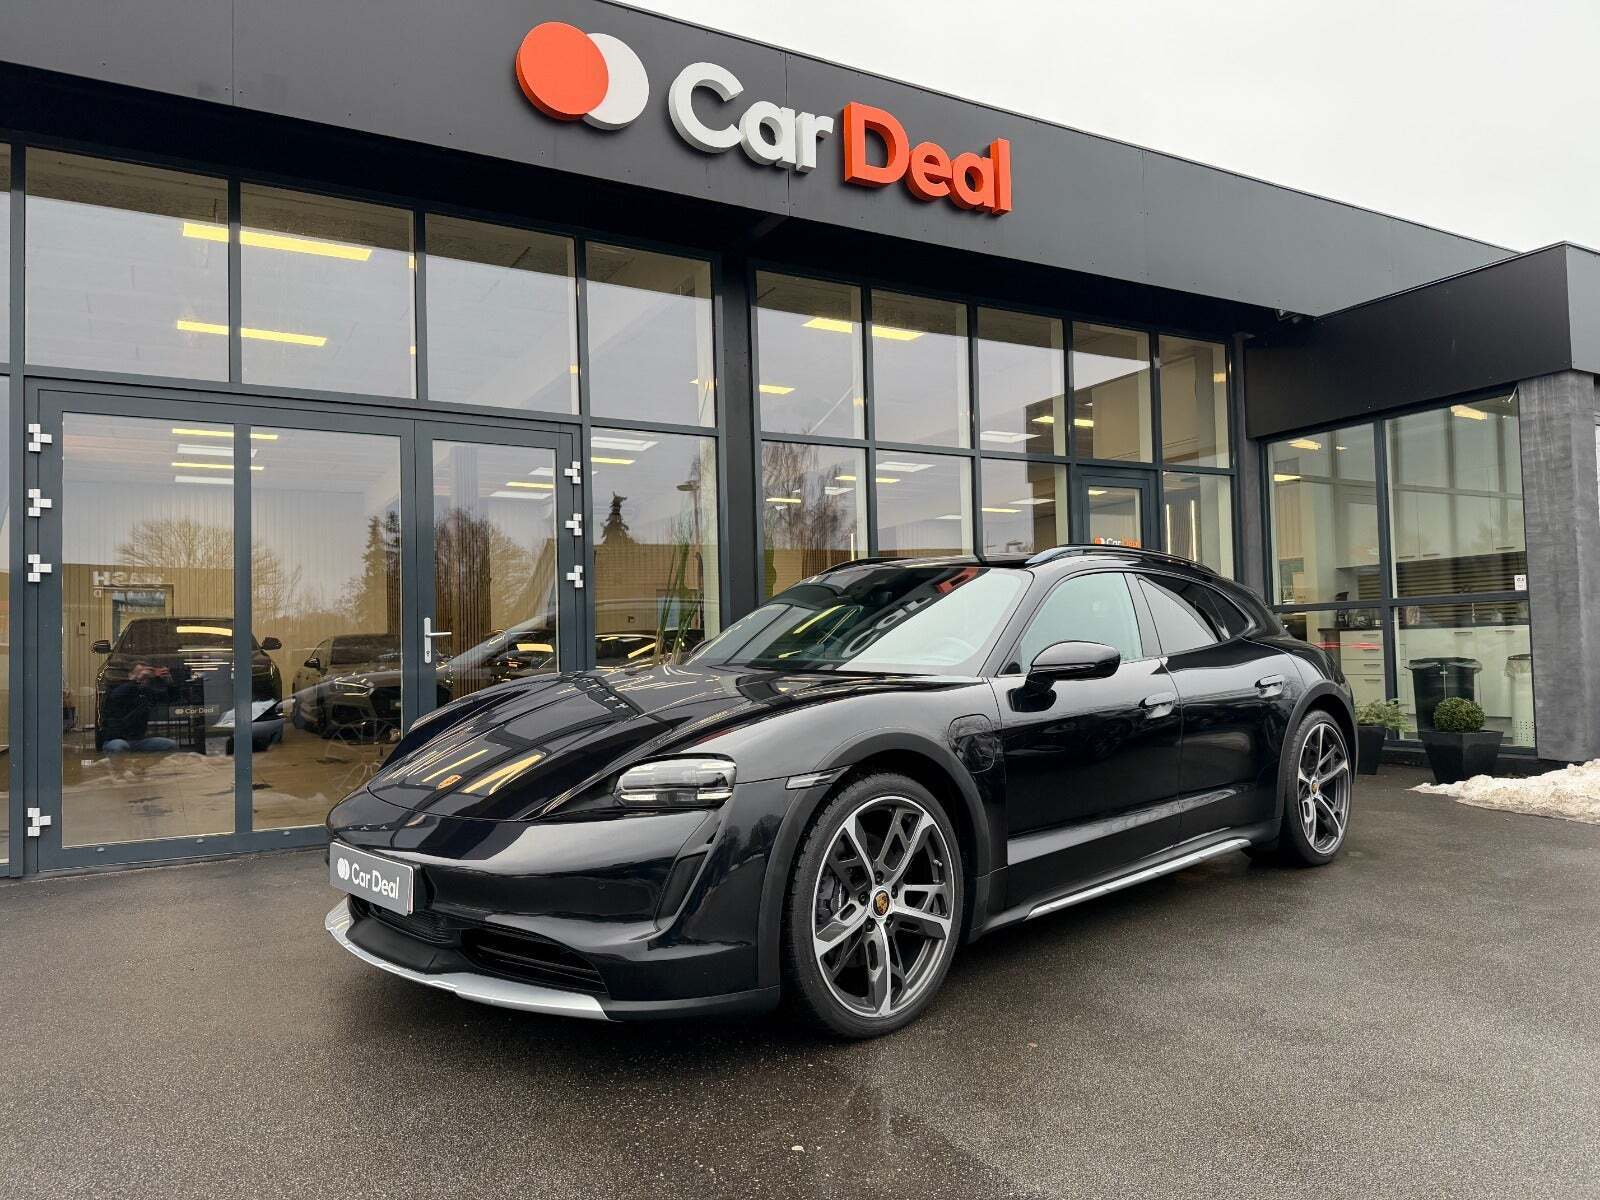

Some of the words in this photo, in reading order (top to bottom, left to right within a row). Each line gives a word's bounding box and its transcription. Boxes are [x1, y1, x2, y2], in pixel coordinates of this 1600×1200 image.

[668, 62, 834, 174] Car
[843, 101, 1012, 215] Deal
[352, 863, 371, 889] Car
[372, 870, 400, 899] Deal
